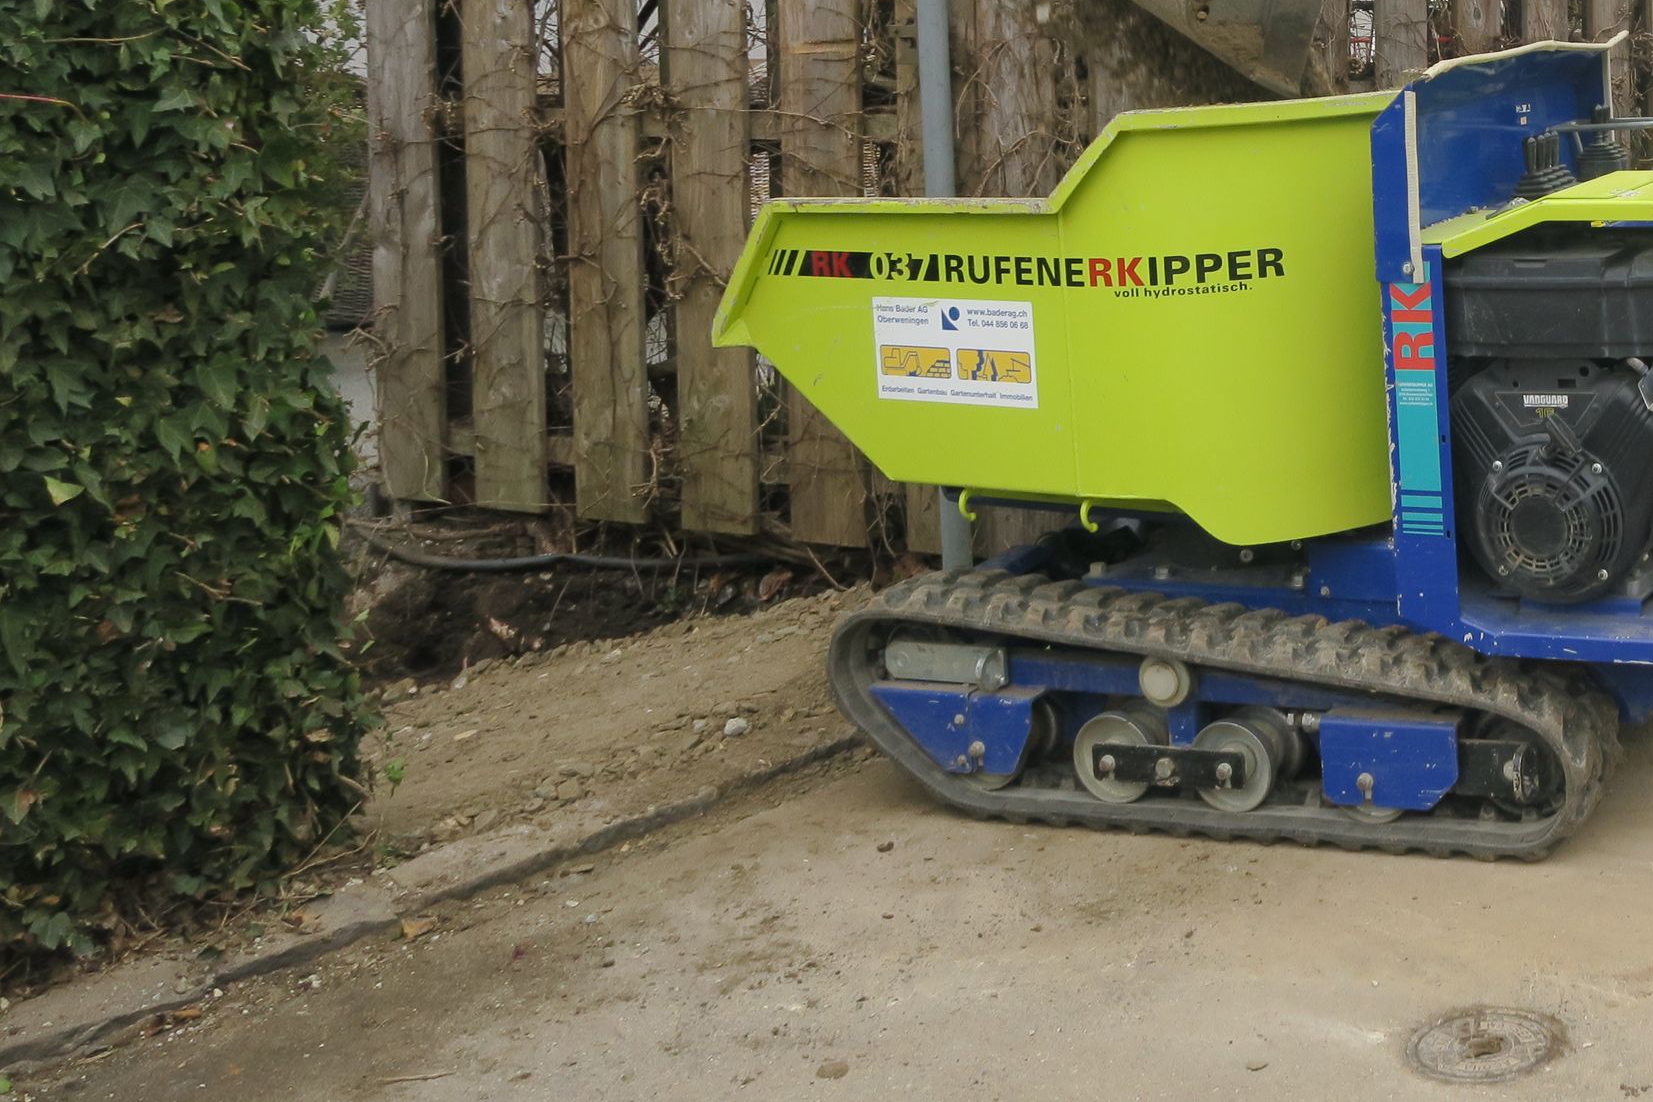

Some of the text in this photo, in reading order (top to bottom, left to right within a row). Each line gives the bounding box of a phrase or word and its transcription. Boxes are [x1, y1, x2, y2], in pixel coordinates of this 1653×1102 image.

[811, 251, 854, 278] RK
[945, 248, 1285, 287] RUFENERKIPPER
[1114, 282, 1252, 299] voll hydrostatisch.
[917, 305, 928, 314] AG
[967, 308, 1028, 319] www.baderag.ch
[1389, 282, 1435, 370] RK
[1523, 395, 1568, 405] VANGUARD
